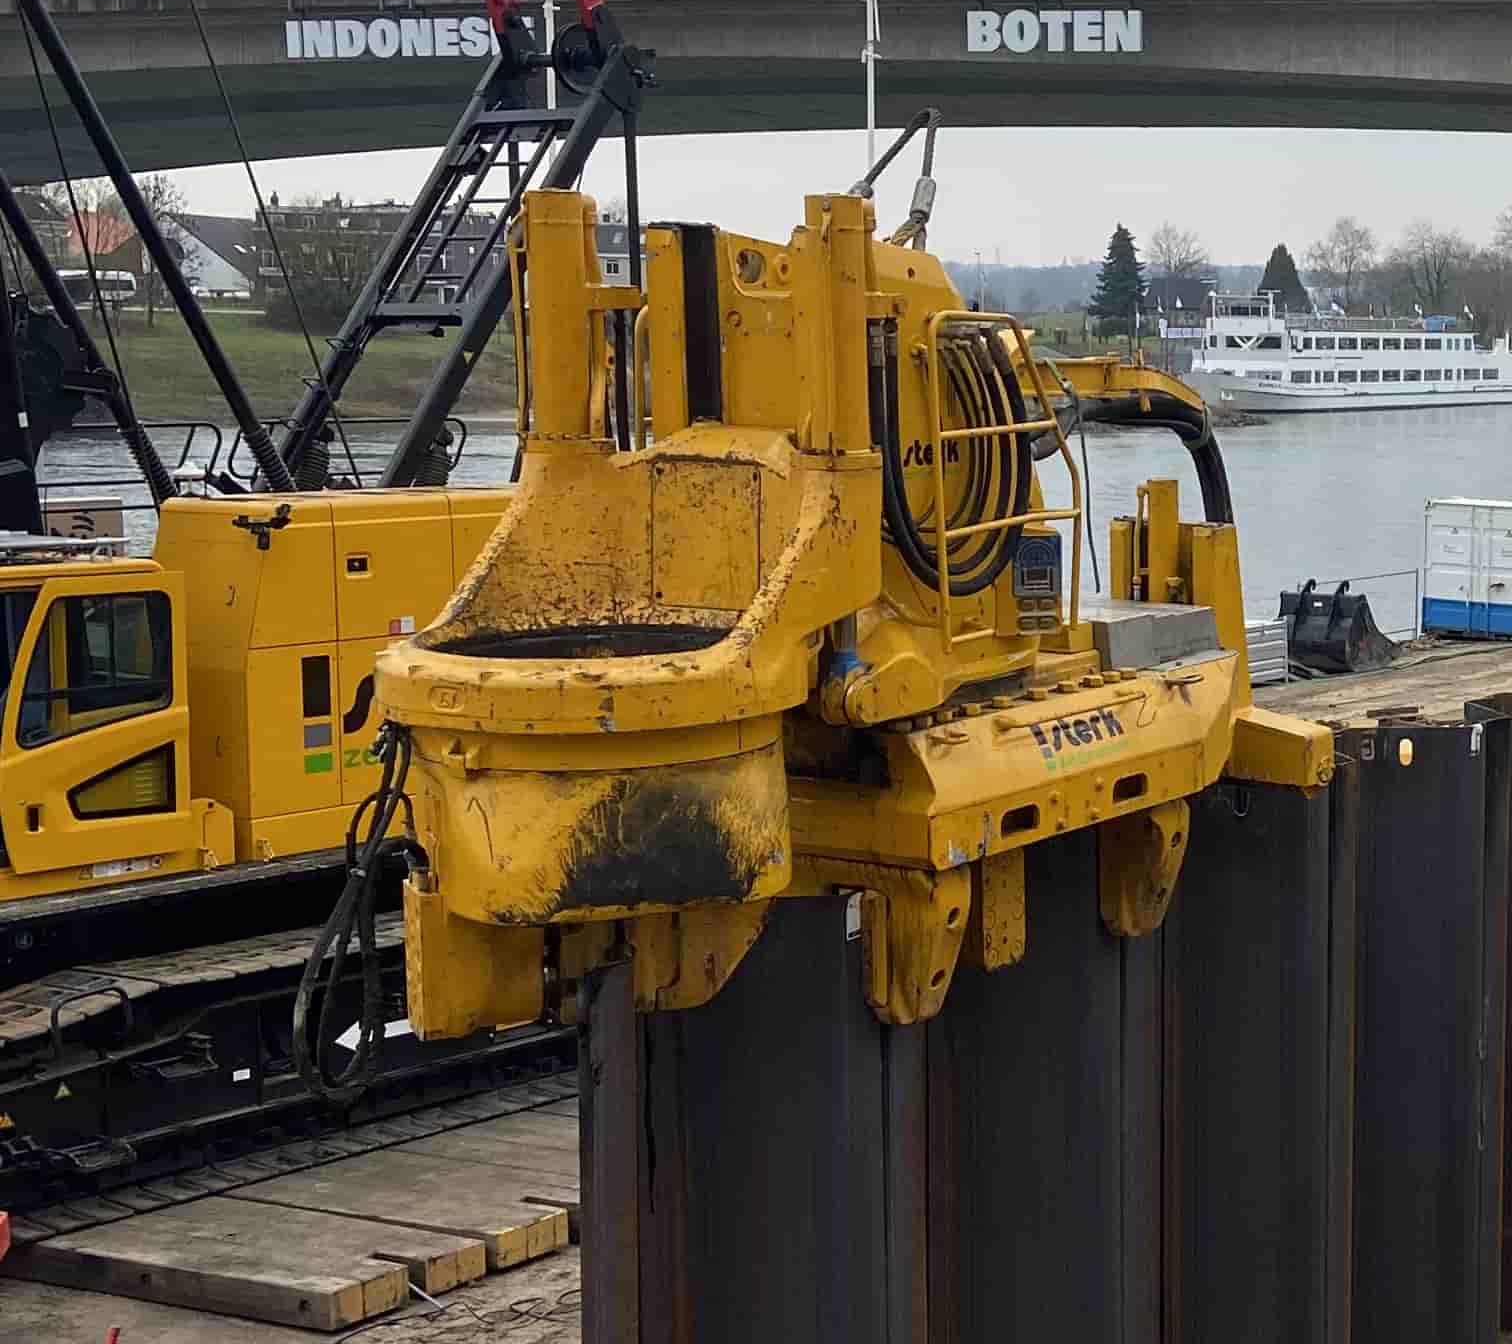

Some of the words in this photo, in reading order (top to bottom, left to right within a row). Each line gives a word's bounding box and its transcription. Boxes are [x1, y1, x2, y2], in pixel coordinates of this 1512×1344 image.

[284, 17, 534, 57] INDONES
[966, 9, 1142, 52] BOTEN
[903, 440, 959, 467] stek
